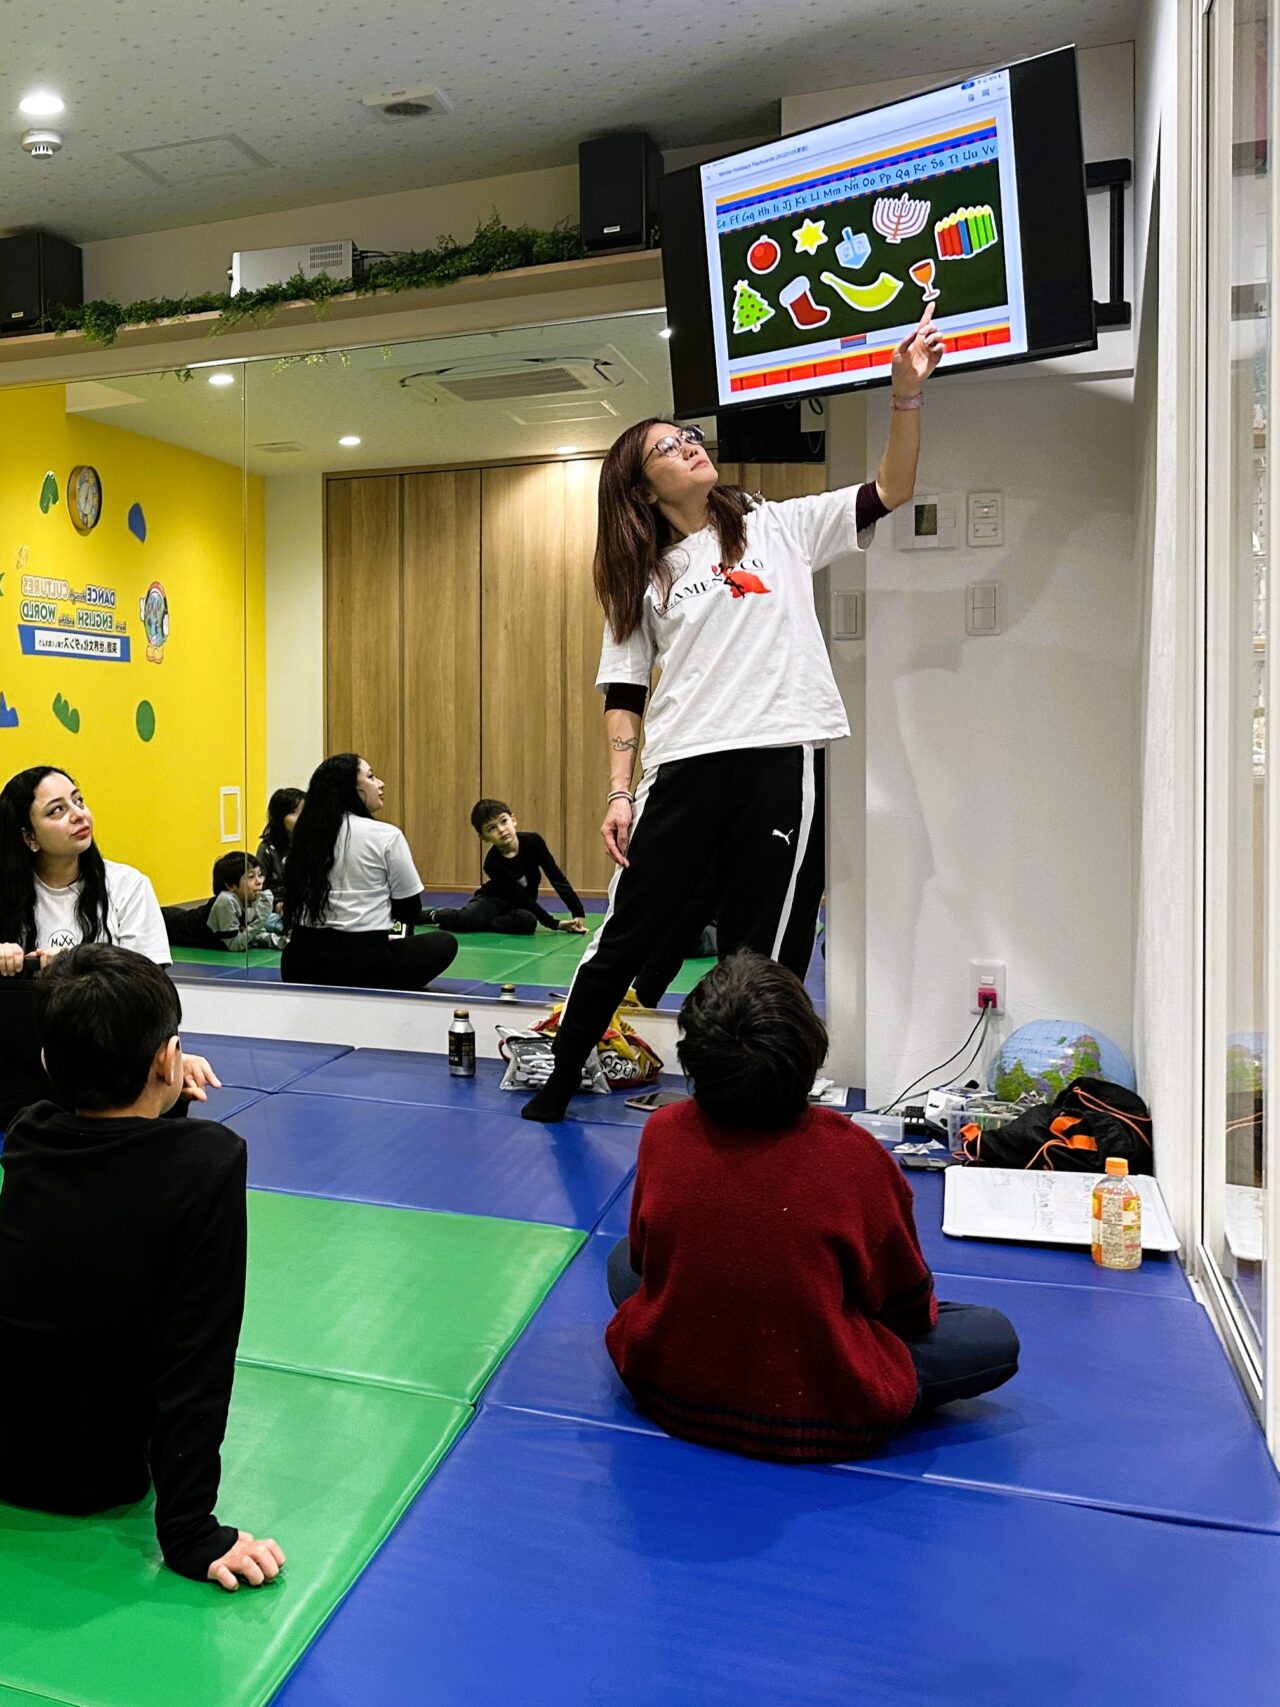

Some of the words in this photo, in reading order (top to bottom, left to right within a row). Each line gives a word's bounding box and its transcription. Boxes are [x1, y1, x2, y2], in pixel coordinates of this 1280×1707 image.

[730, 215, 739, 226] Ff
[742, 211, 755, 222] Gg
[758, 206, 770, 217] Hh
[782, 200, 792, 212] Jj
[795, 196, 808, 206] Kk
[810, 193, 820, 203] Ll
[823, 188, 841, 199] Mm
[844, 182, 859, 193] Nn
[862, 177, 875, 187] Oo
[879, 173, 892, 184] Pp
[895, 169, 910, 180] Qq
[913, 163, 927, 175] Rr
[930, 158, 945, 169] Ss
[947, 154, 959, 166] Tt
[962, 150, 978, 161] Uu
[982, 145, 996, 156] Vv
